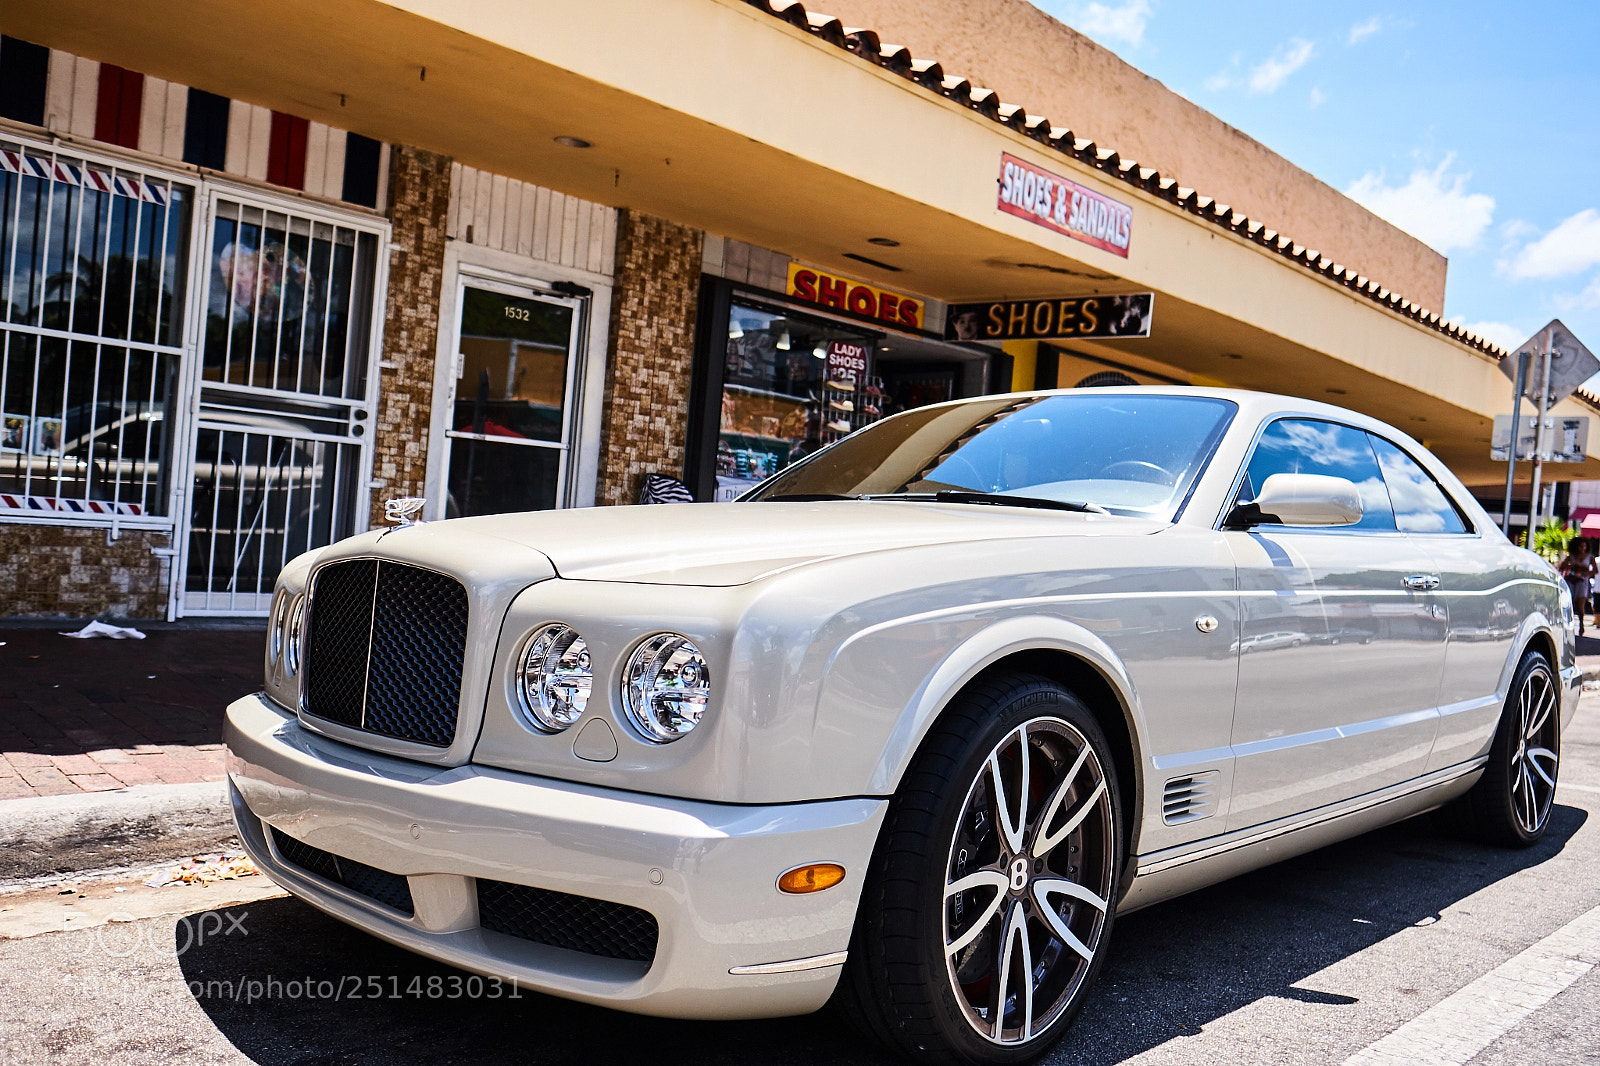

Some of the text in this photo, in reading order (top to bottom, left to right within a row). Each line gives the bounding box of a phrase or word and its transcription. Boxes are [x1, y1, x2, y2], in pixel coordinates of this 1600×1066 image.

[1001, 161, 1132, 249] SHOES & SANDALS
[504, 306, 530, 321] 1532
[793, 269, 919, 327] SHOES
[986, 299, 1099, 336] SHOES
[829, 353, 865, 370] SHOES
[834, 343, 862, 357] LADY
[1010, 858, 1028, 890] B
